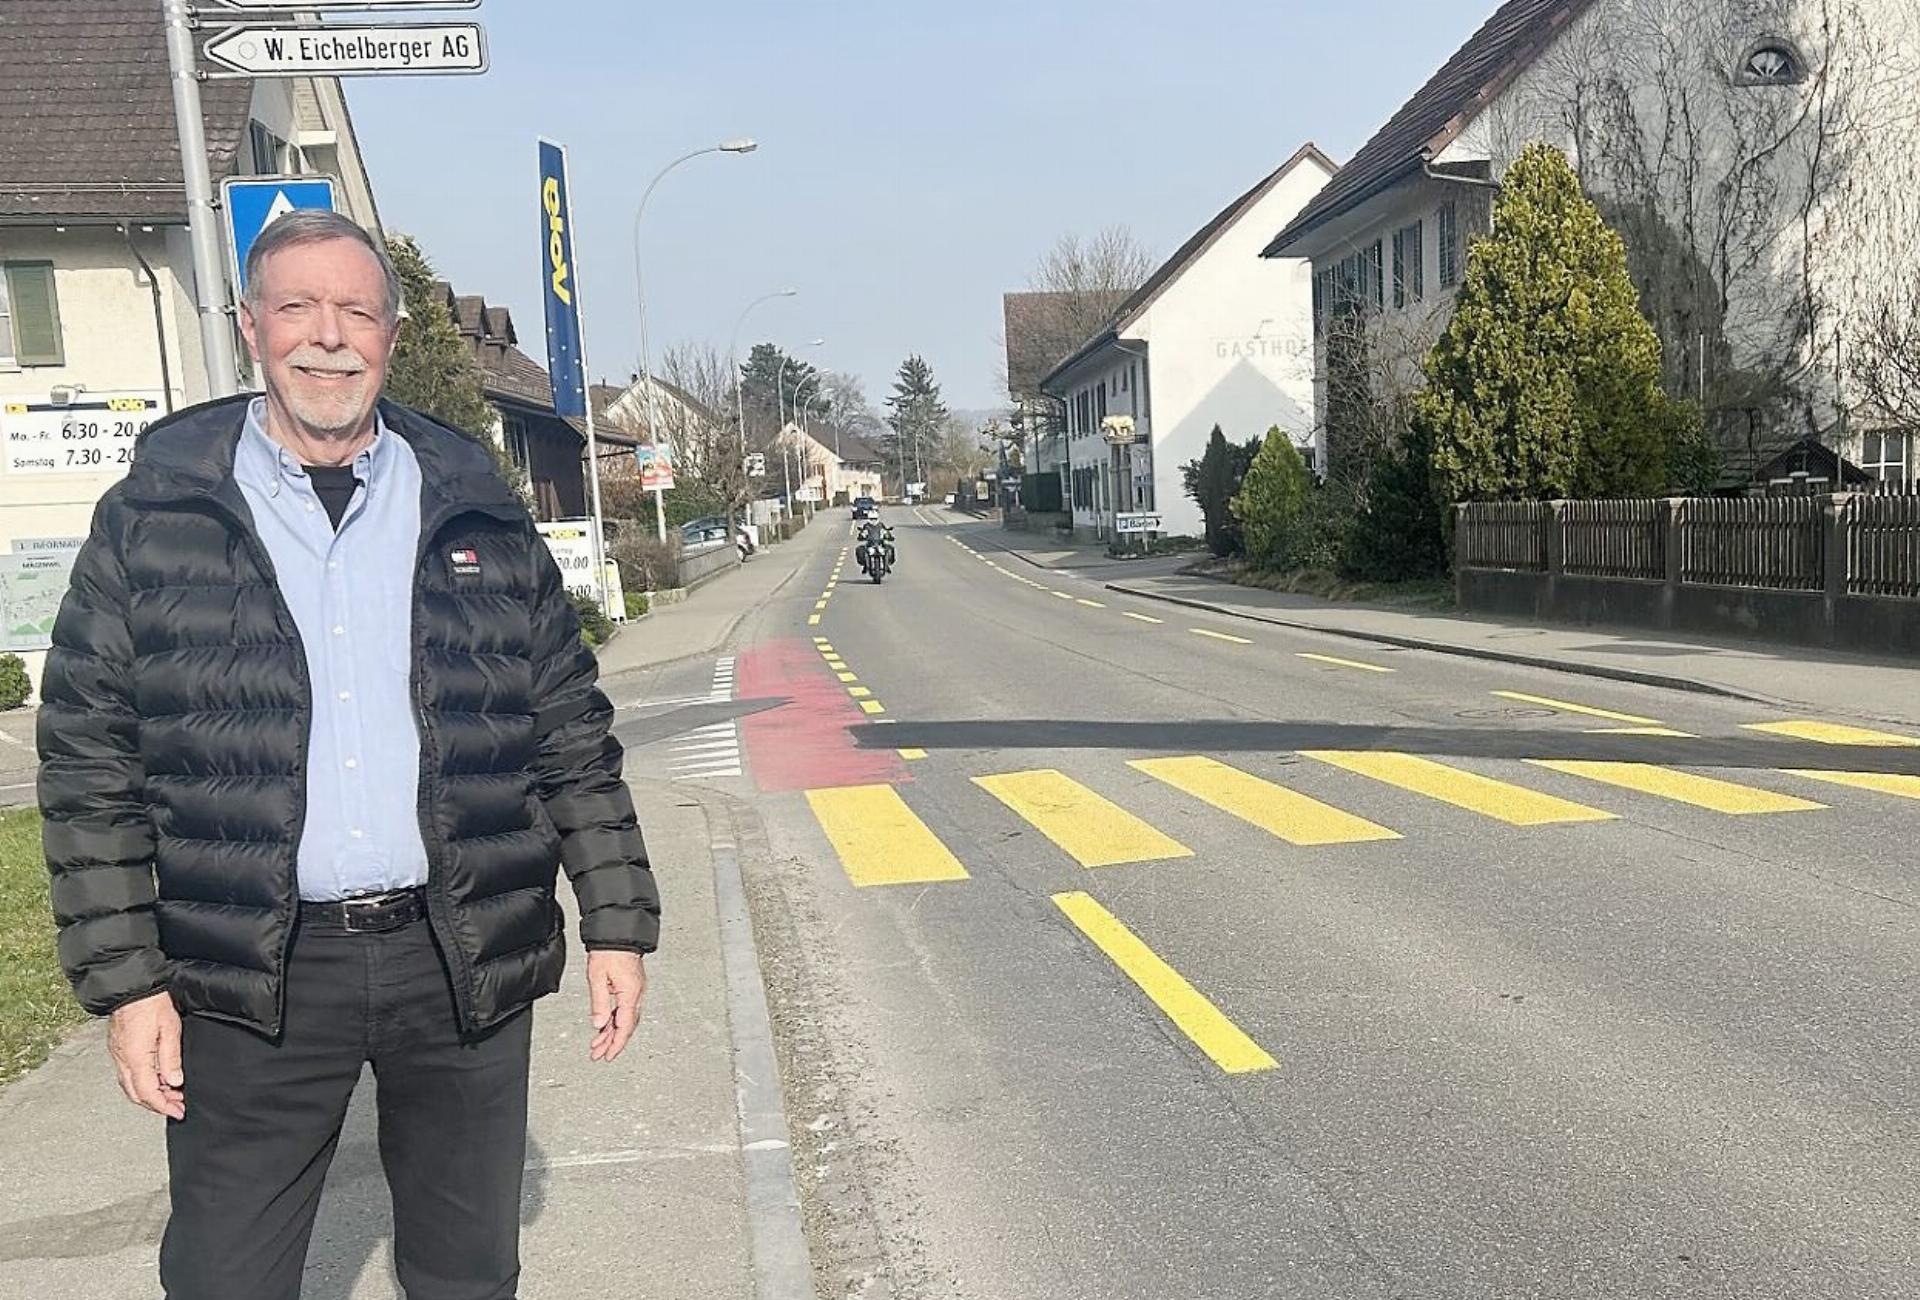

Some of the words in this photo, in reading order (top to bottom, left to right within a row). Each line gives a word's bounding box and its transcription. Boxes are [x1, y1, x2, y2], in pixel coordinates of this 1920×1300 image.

[264, 37, 293, 61] W.
[300, 35, 432, 65] Eichelberger
[442, 35, 469, 58] AG
[62, 423, 98, 440] 6.30
[66, 449, 101, 466] 7.30
